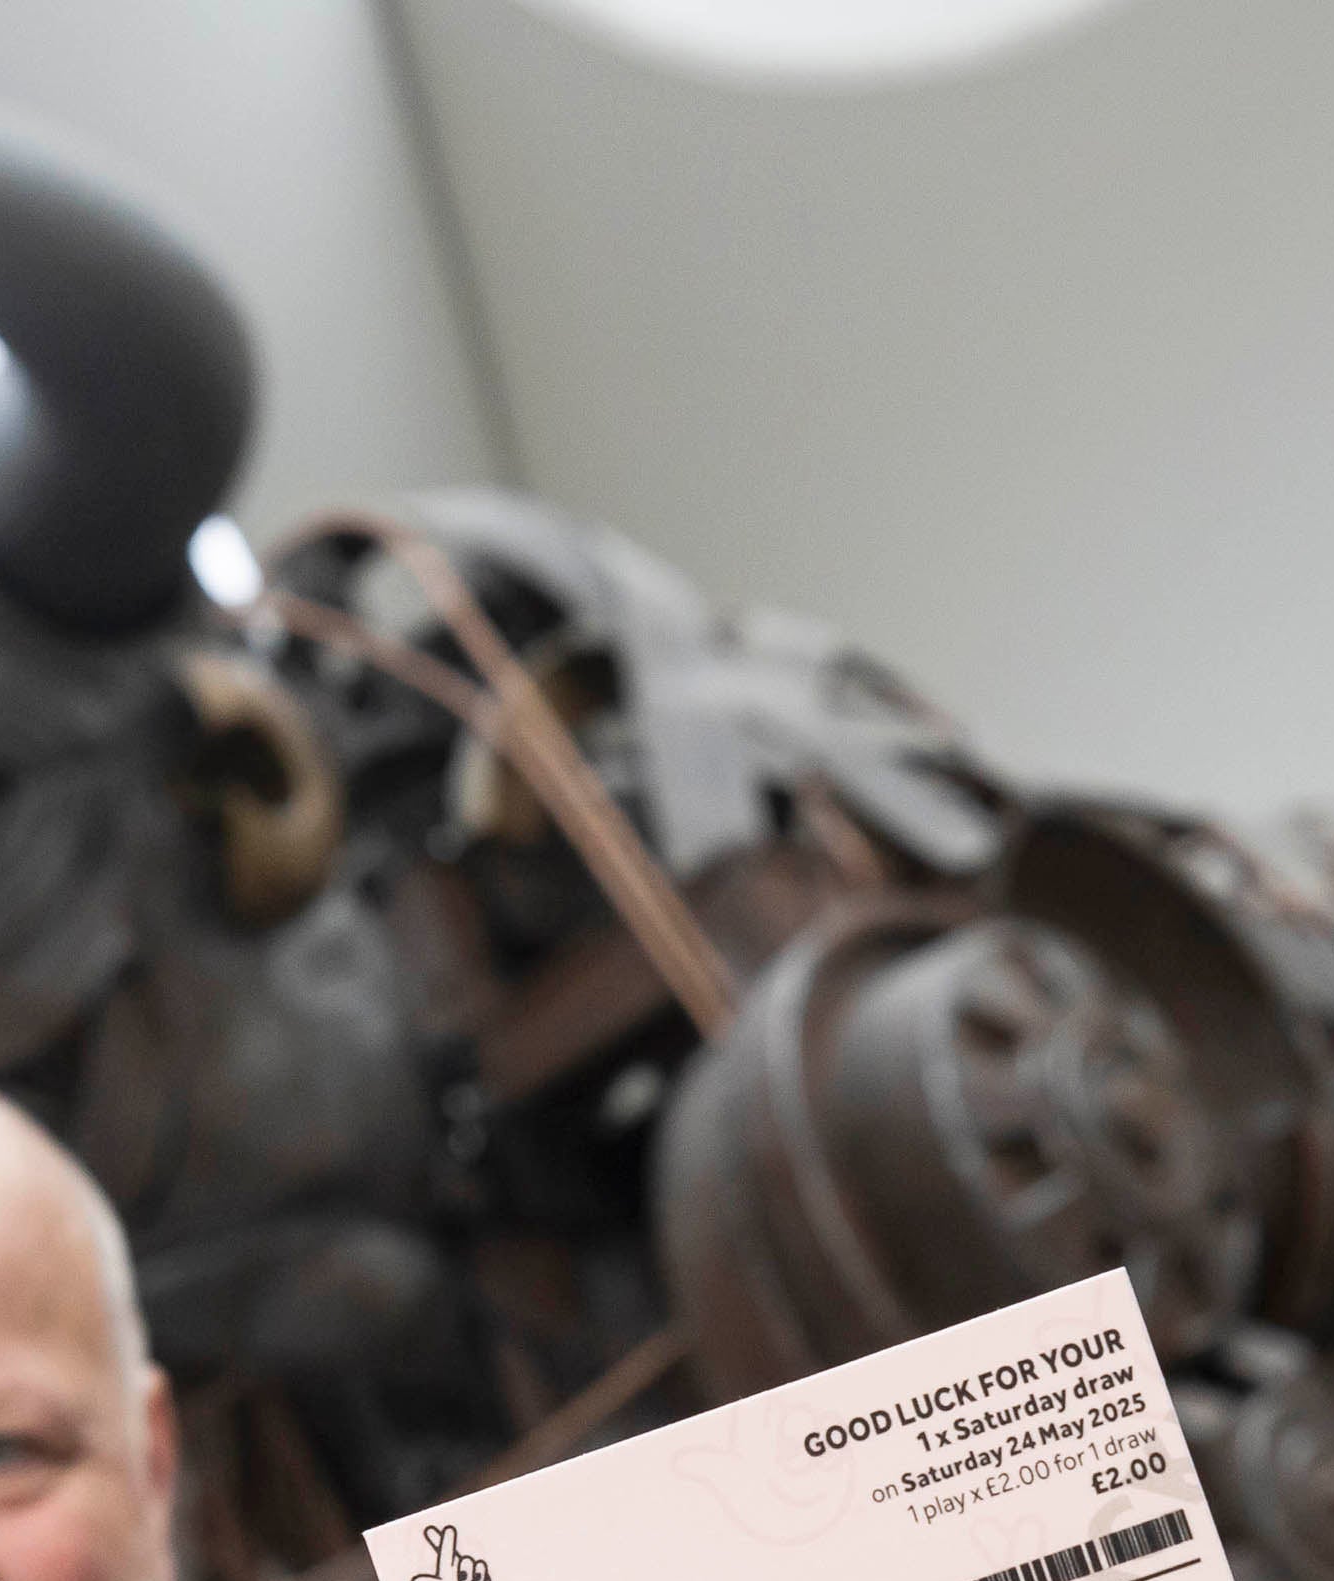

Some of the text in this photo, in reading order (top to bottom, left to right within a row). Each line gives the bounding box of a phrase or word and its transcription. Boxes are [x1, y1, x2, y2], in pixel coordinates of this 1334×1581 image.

[802, 1327, 1127, 1459] GOOD LUCK FOR YOUR
[915, 1364, 1135, 1453] 1 x Saturday draw
[871, 1391, 1147, 1504] on Saturday 24 May 2025
[906, 1426, 1157, 1526] 1 play x £2.00 for 1 draw
[1090, 1450, 1168, 1496] £2.00
